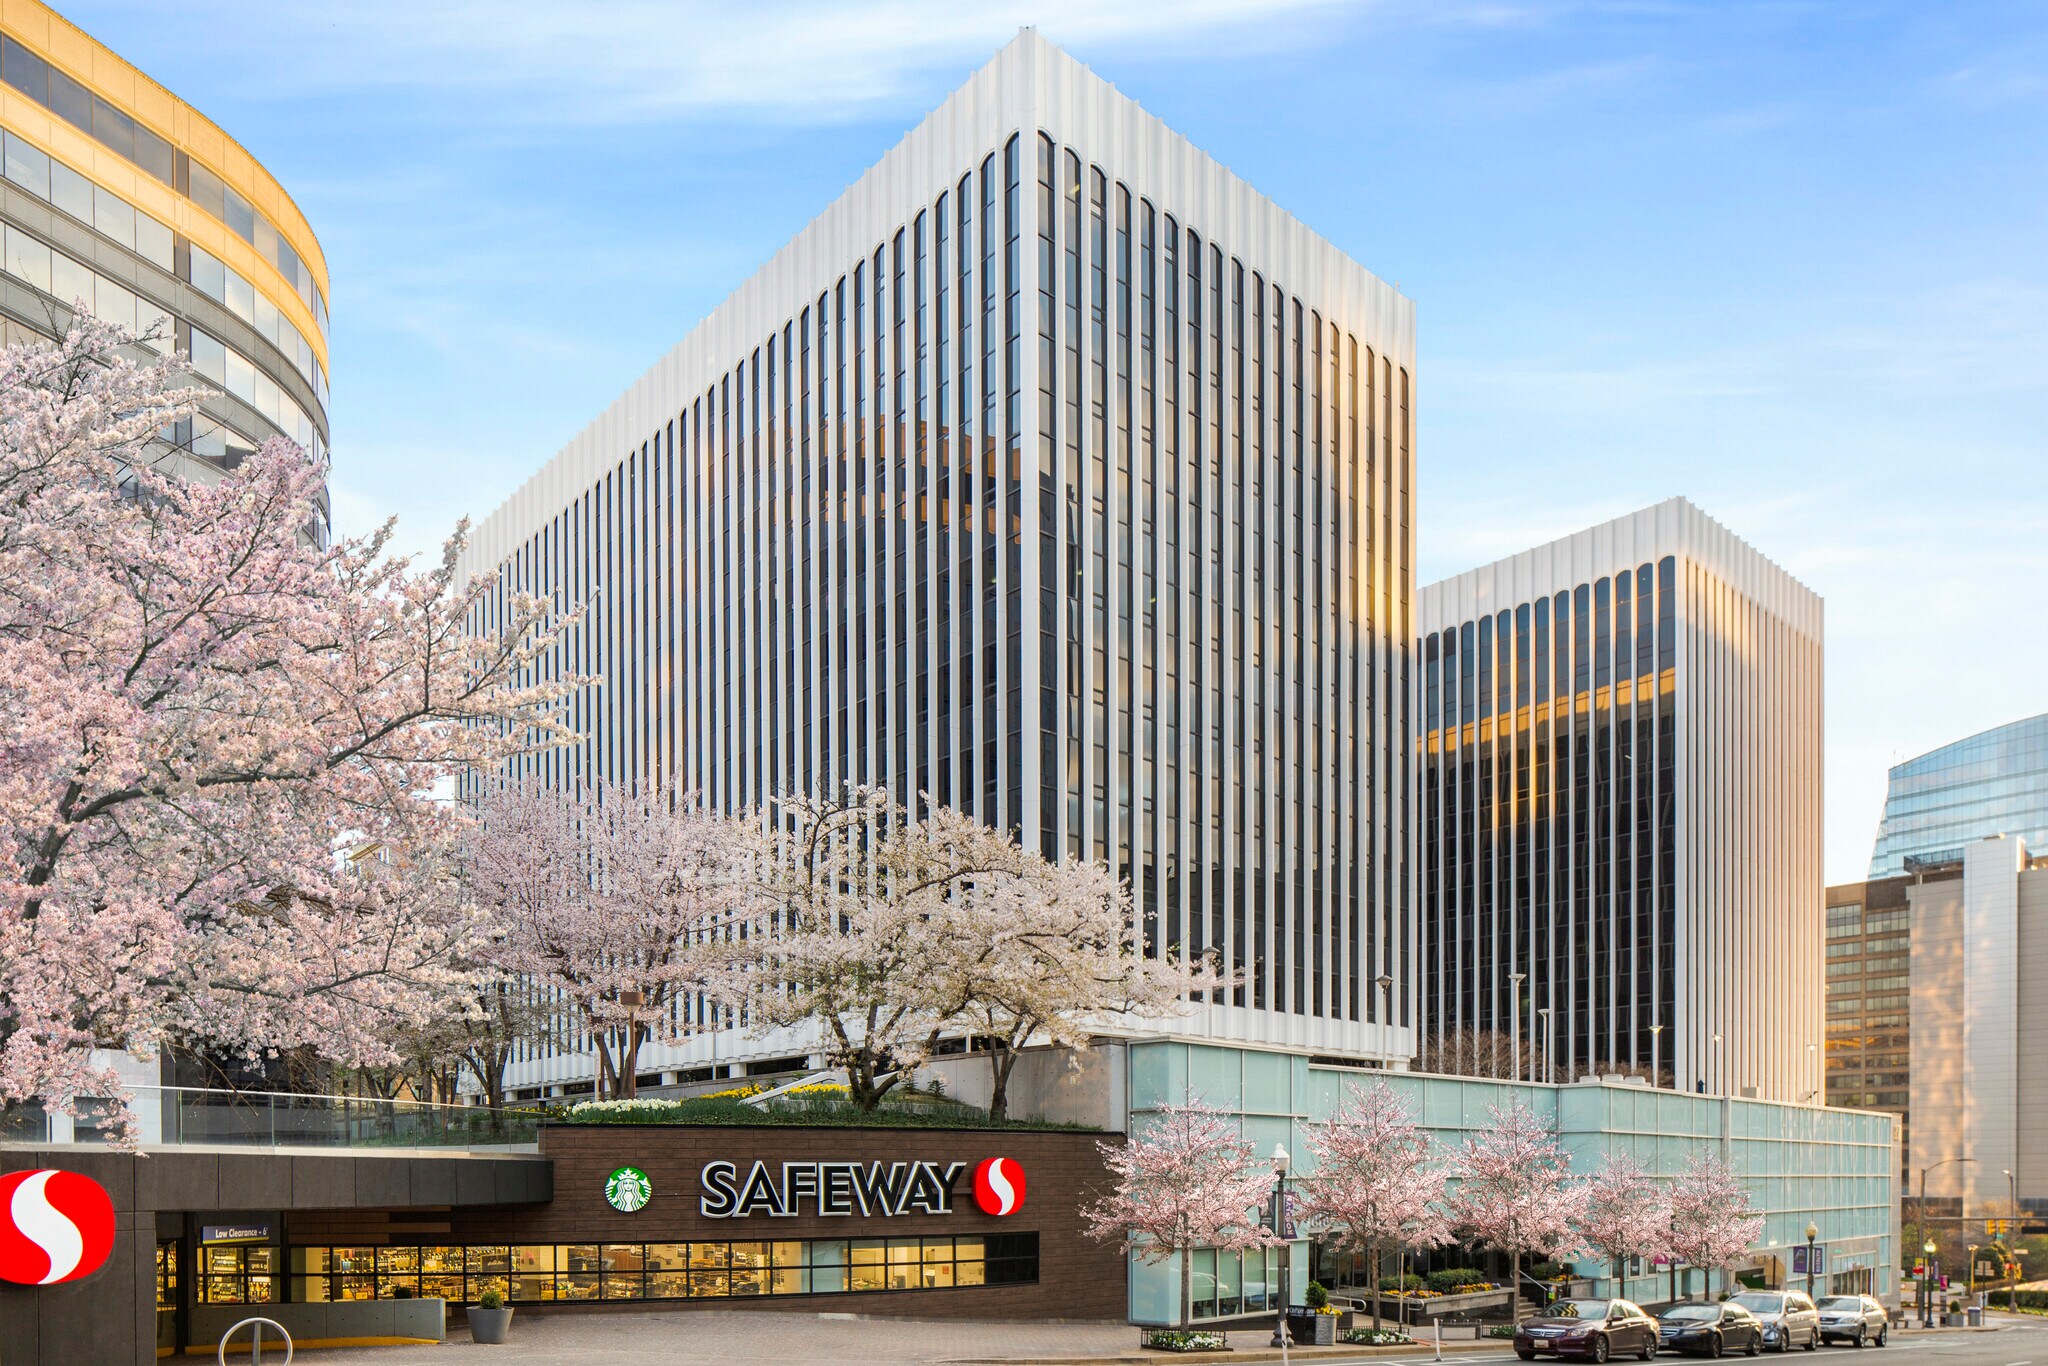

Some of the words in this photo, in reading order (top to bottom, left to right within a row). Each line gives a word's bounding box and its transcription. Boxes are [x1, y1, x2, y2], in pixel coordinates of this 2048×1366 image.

[701, 1160, 967, 1218] SAFEWAY
[215, 1229, 227, 1238] Low
[229, 1228, 257, 1237] Clearance
